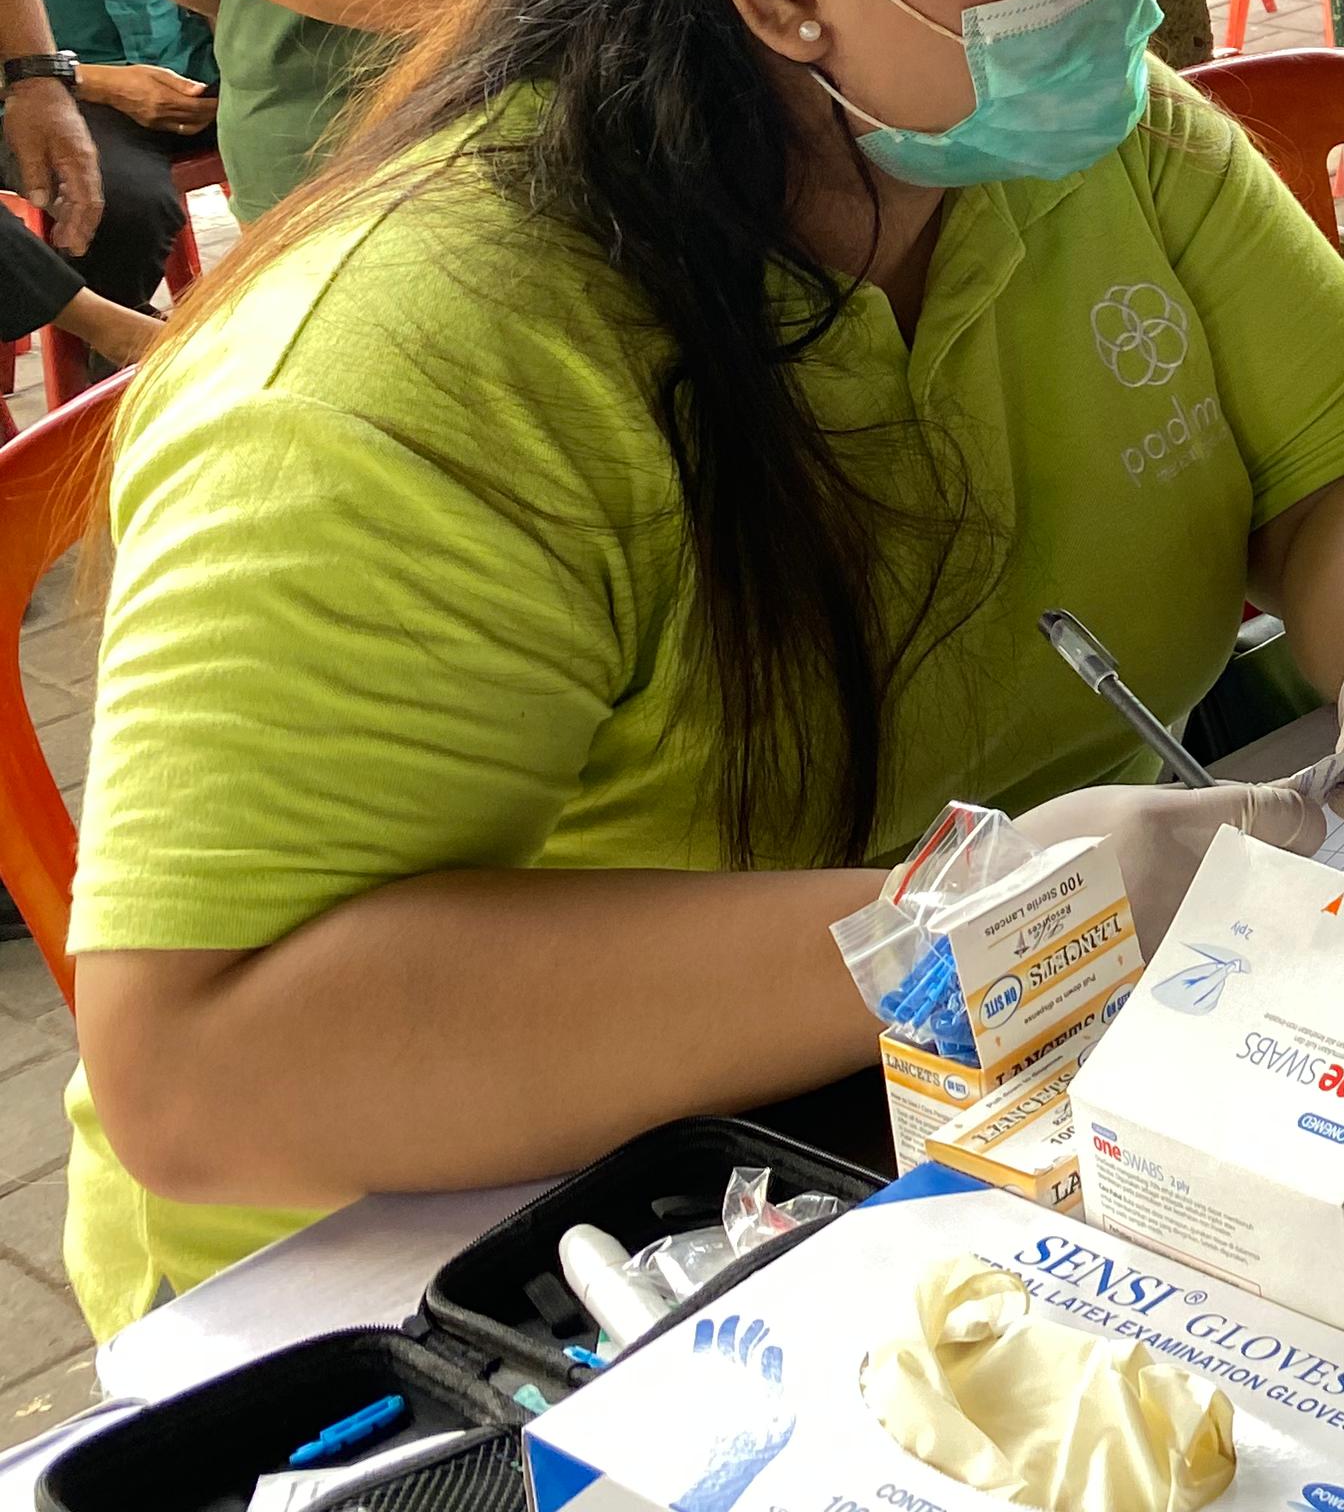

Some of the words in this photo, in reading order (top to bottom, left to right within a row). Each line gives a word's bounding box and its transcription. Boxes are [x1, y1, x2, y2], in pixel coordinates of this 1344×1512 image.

[1060, 872, 1084, 896] 100
[1027, 888, 1057, 911] Sterile
[1029, 912, 1122, 987] LANCETS
[984, 993, 1006, 1019] SITE
[1006, 986, 1017, 1006] ON
[886, 1054, 941, 1085] LANCETS
[1045, 1290, 1119, 1327] LATEX
[1114, 1319, 1268, 1391] EXAMINATION
